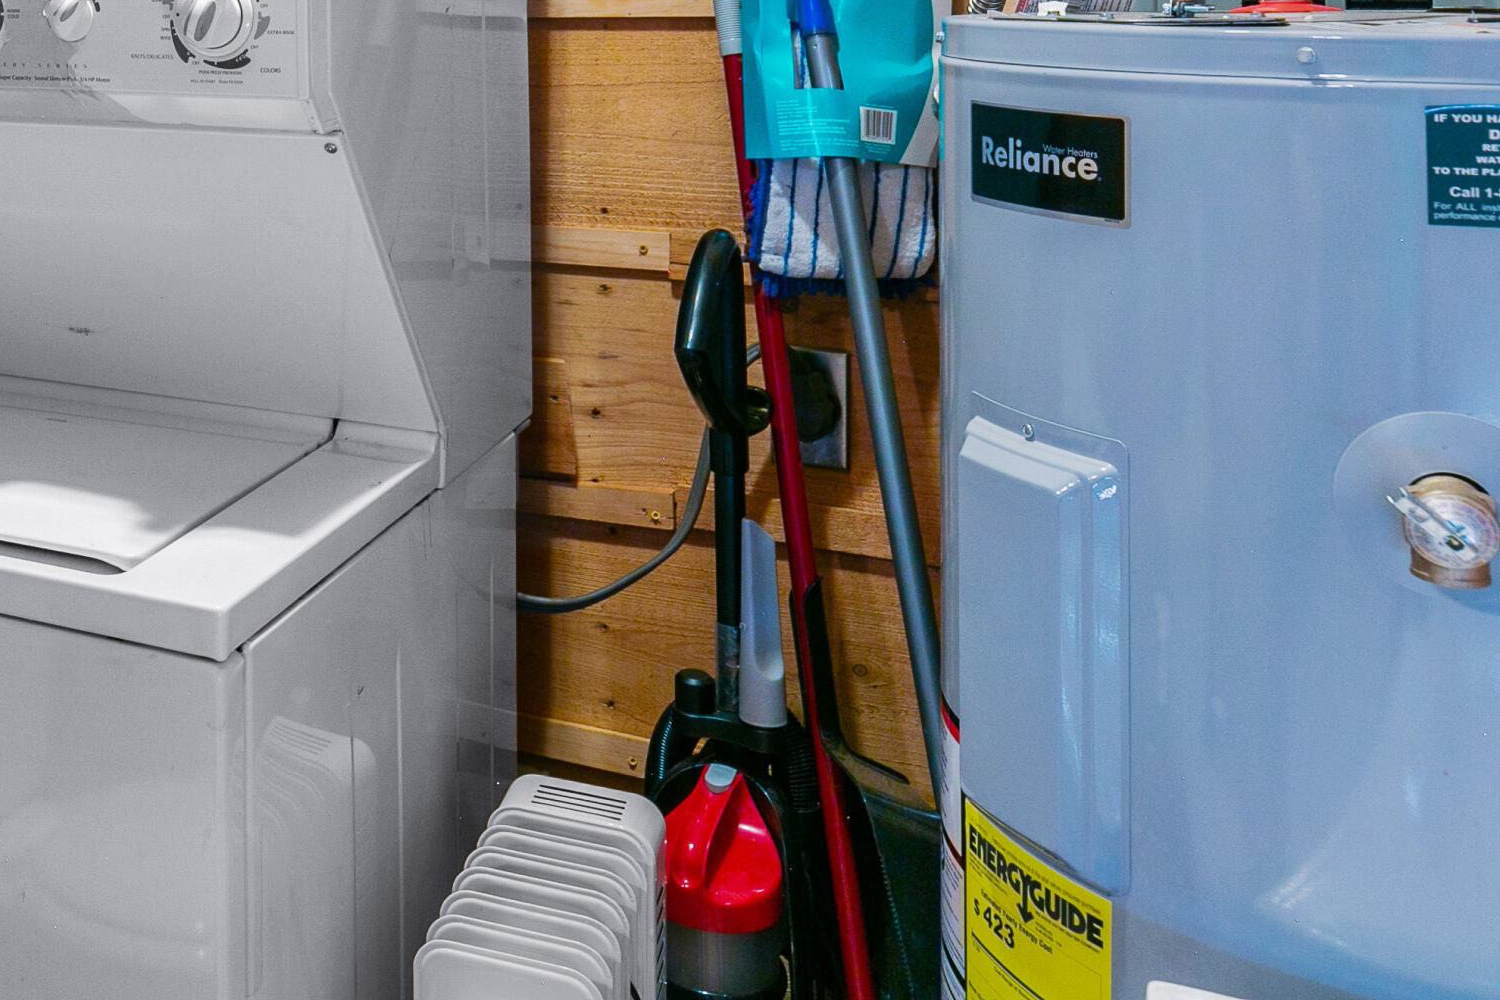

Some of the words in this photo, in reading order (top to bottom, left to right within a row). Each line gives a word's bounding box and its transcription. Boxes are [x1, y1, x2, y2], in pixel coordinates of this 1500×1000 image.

[1434, 114, 1447, 122] IF
[1452, 114, 1483, 123] YOU
[1042, 144, 1065, 154] Water
[1067, 147, 1098, 159] Heaters
[981, 135, 1098, 181] Reliance
[1432, 167, 1450, 175] TO
[1453, 167, 1479, 175] THE
[1449, 186, 1480, 198] Call
[1434, 202, 1452, 210] For
[1456, 203, 1476, 211] ALL
[1433, 212, 1496, 221] performance
[983, 906, 1015, 948] 423
